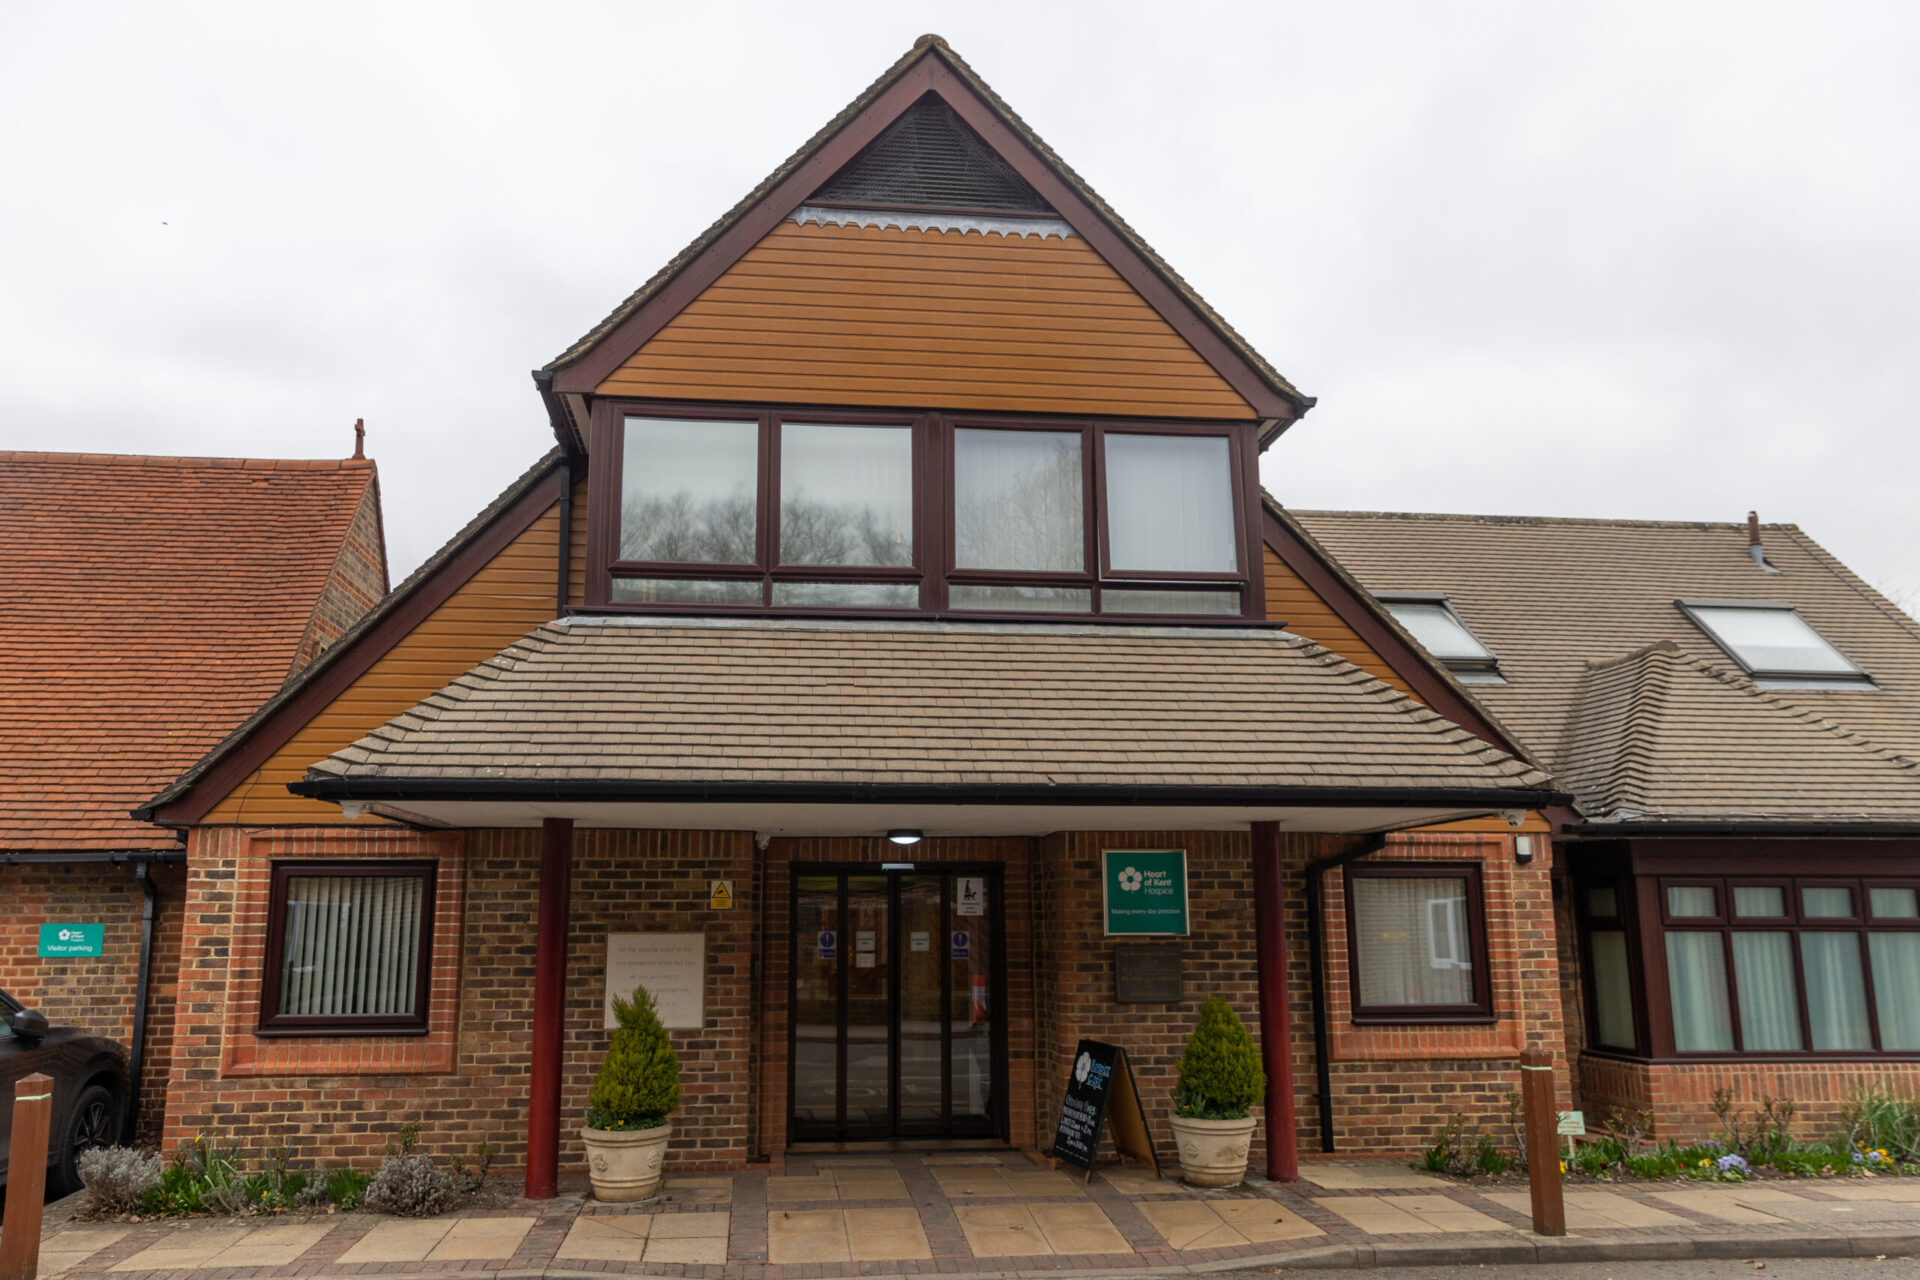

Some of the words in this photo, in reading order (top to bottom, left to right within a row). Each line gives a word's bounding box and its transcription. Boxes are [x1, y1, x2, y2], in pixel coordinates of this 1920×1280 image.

[1143, 870, 1167, 878] Heart
[1144, 878, 1152, 887] of
[1153, 878, 1172, 887] Kent
[1143, 887, 1174, 896] Hospice
[1111, 908, 1131, 916] Making
[47, 944, 67, 952] Visitor
[68, 944, 93, 953] parking
